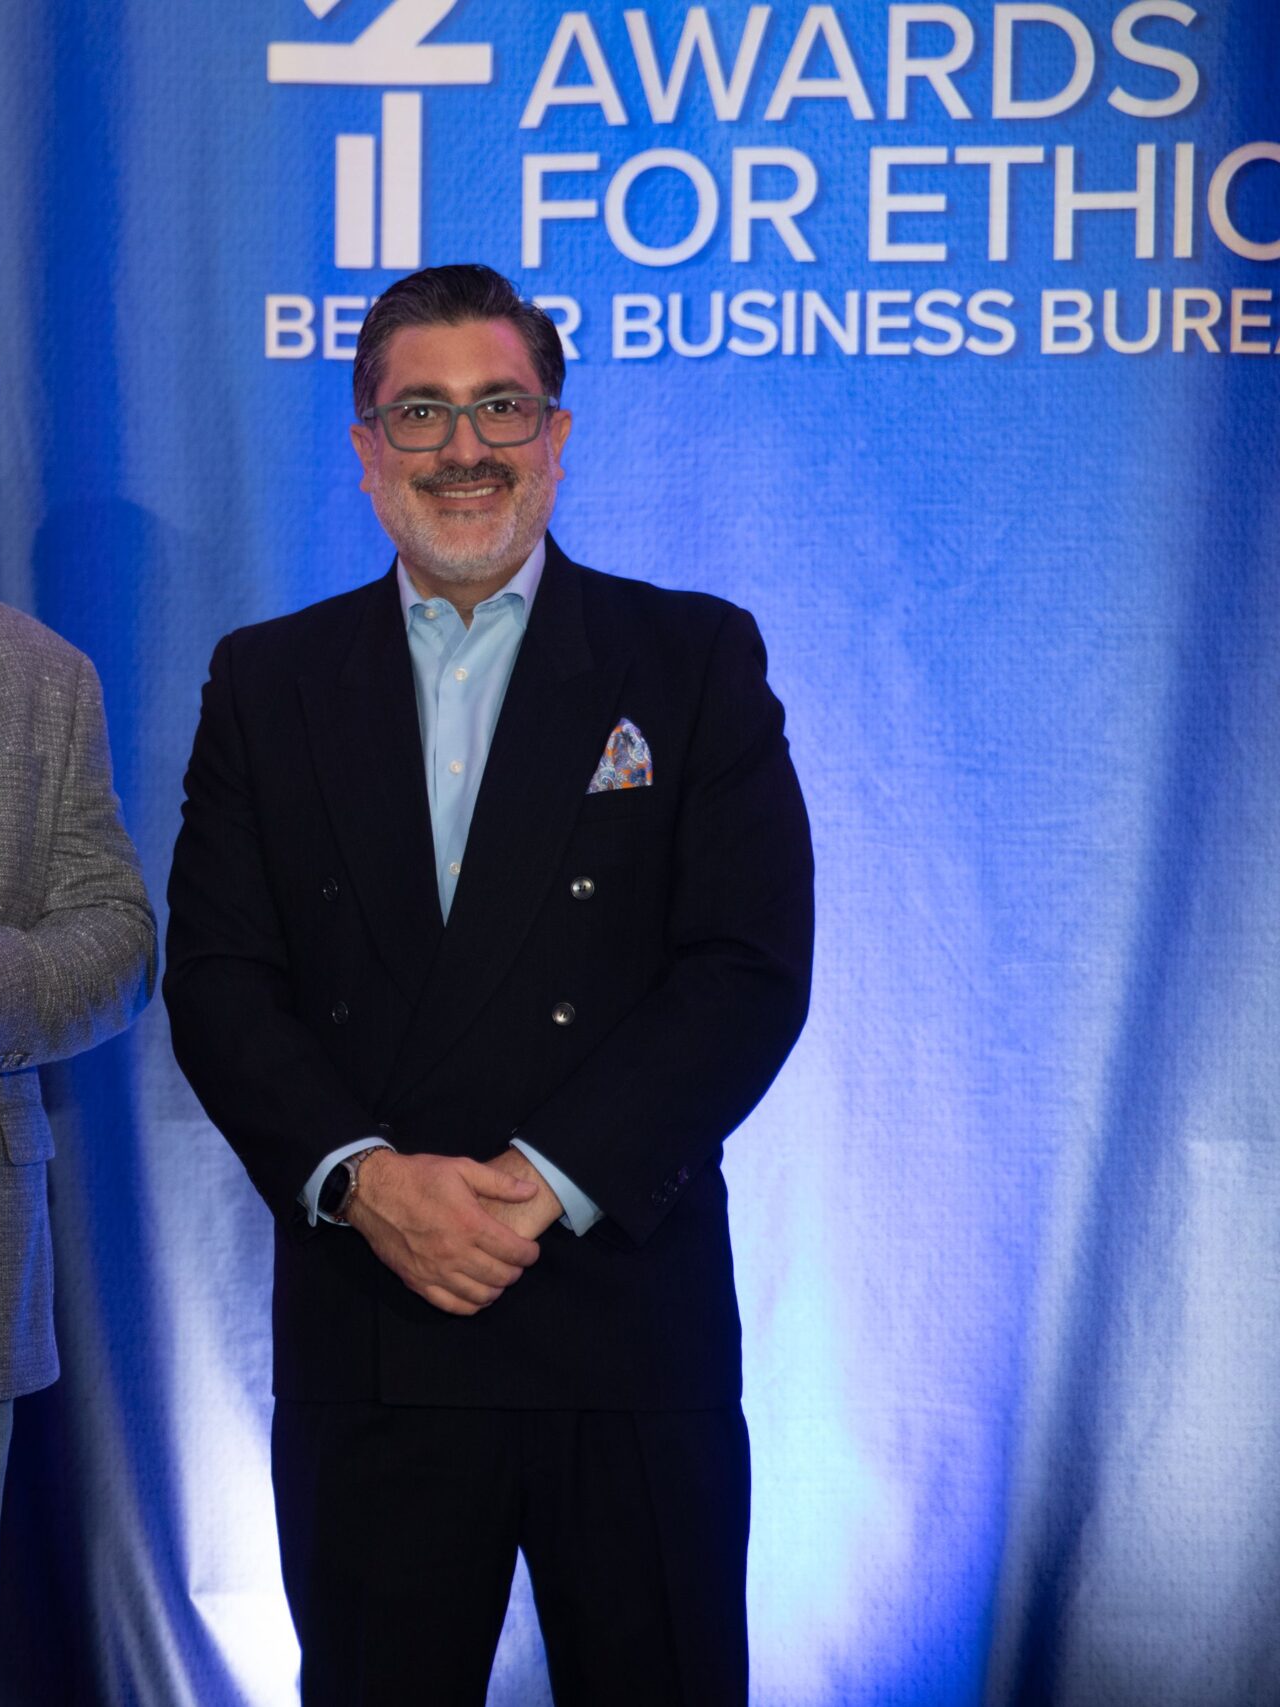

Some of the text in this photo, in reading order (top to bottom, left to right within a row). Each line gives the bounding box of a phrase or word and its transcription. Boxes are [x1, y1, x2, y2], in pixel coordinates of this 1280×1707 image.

[520, 0, 1199, 129] AWARDS
[521, 142, 1280, 268] FOR ETHIC
[265, 288, 1280, 360] BER BUSINESS BURE
